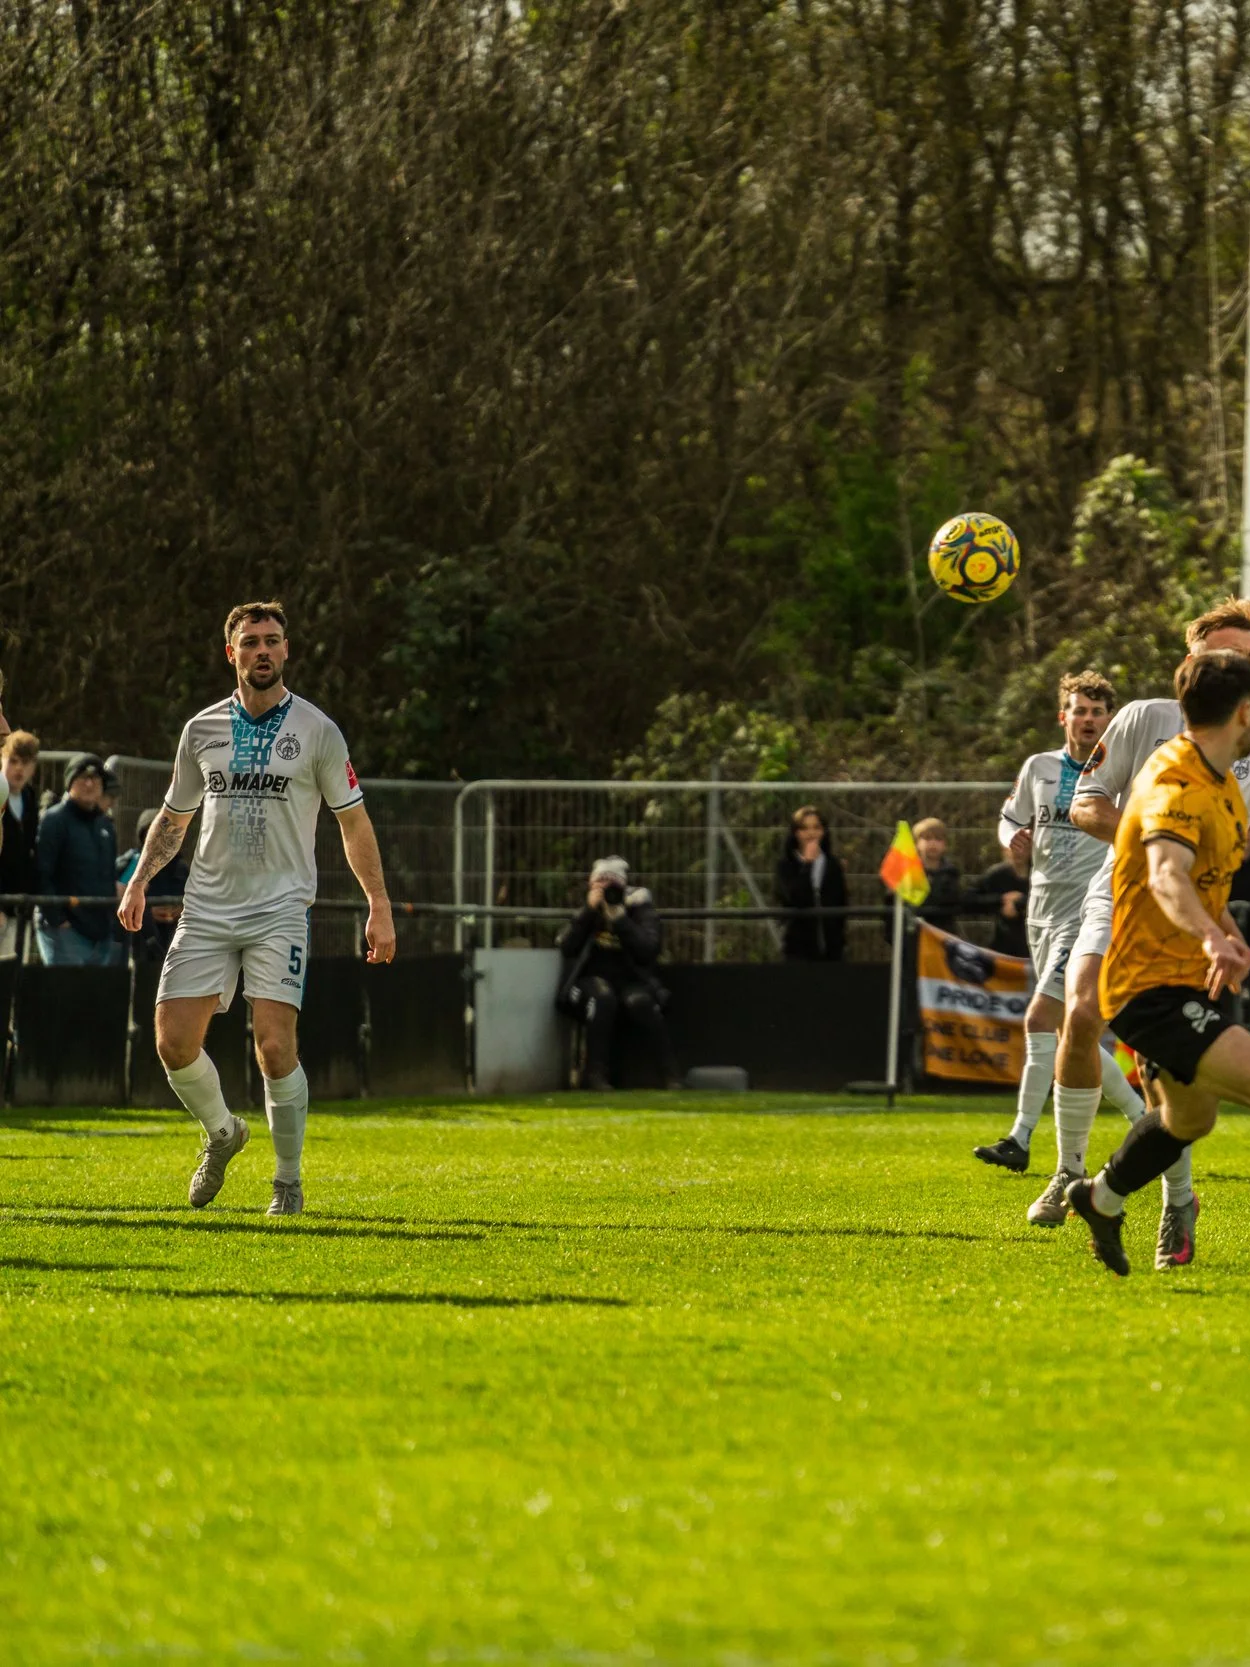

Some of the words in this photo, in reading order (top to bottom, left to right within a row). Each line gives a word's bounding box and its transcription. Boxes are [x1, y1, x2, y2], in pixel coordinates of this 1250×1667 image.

[230, 773, 290, 793] MAPEI
[288, 944, 302, 975] 5
[937, 986, 1003, 1011] PRIDE
